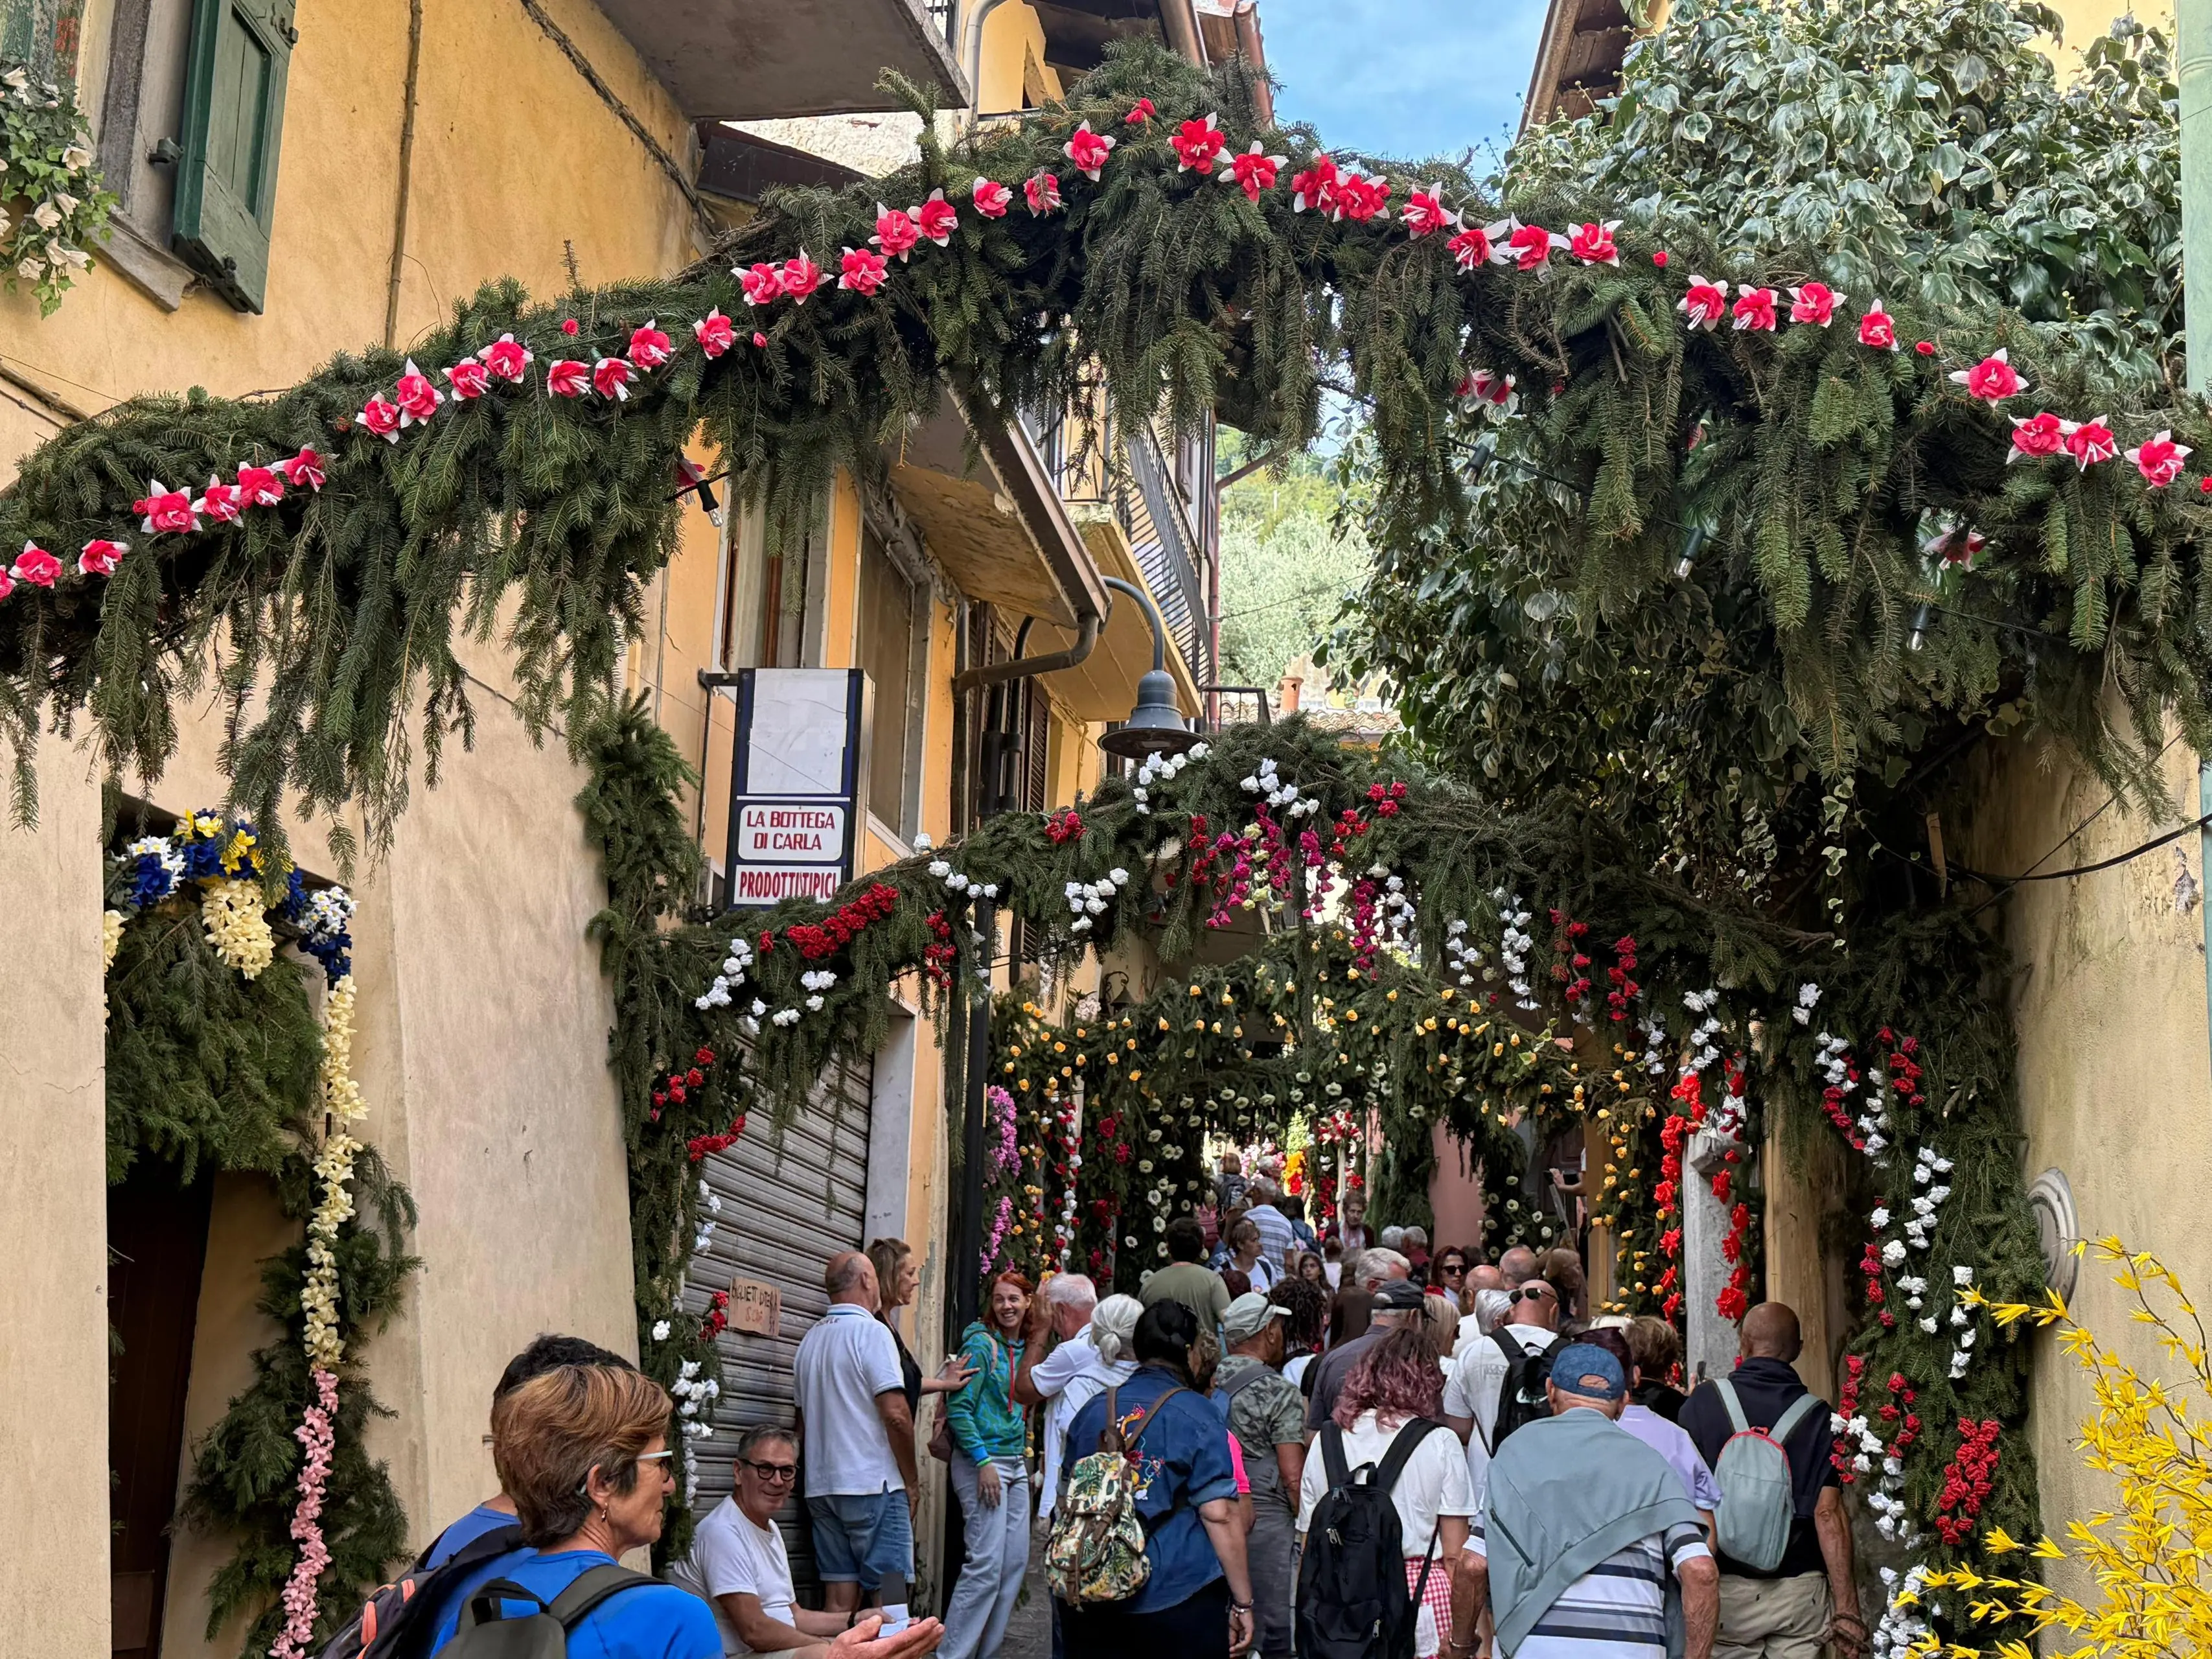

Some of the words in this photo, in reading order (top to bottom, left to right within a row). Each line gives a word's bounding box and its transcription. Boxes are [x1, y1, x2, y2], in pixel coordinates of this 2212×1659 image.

[746, 811, 765, 828] LA
[770, 811, 835, 829] BOTTEGA
[754, 832, 768, 850] DI
[773, 833, 822, 850] CARLA
[739, 871, 800, 898] PRODOTTI
